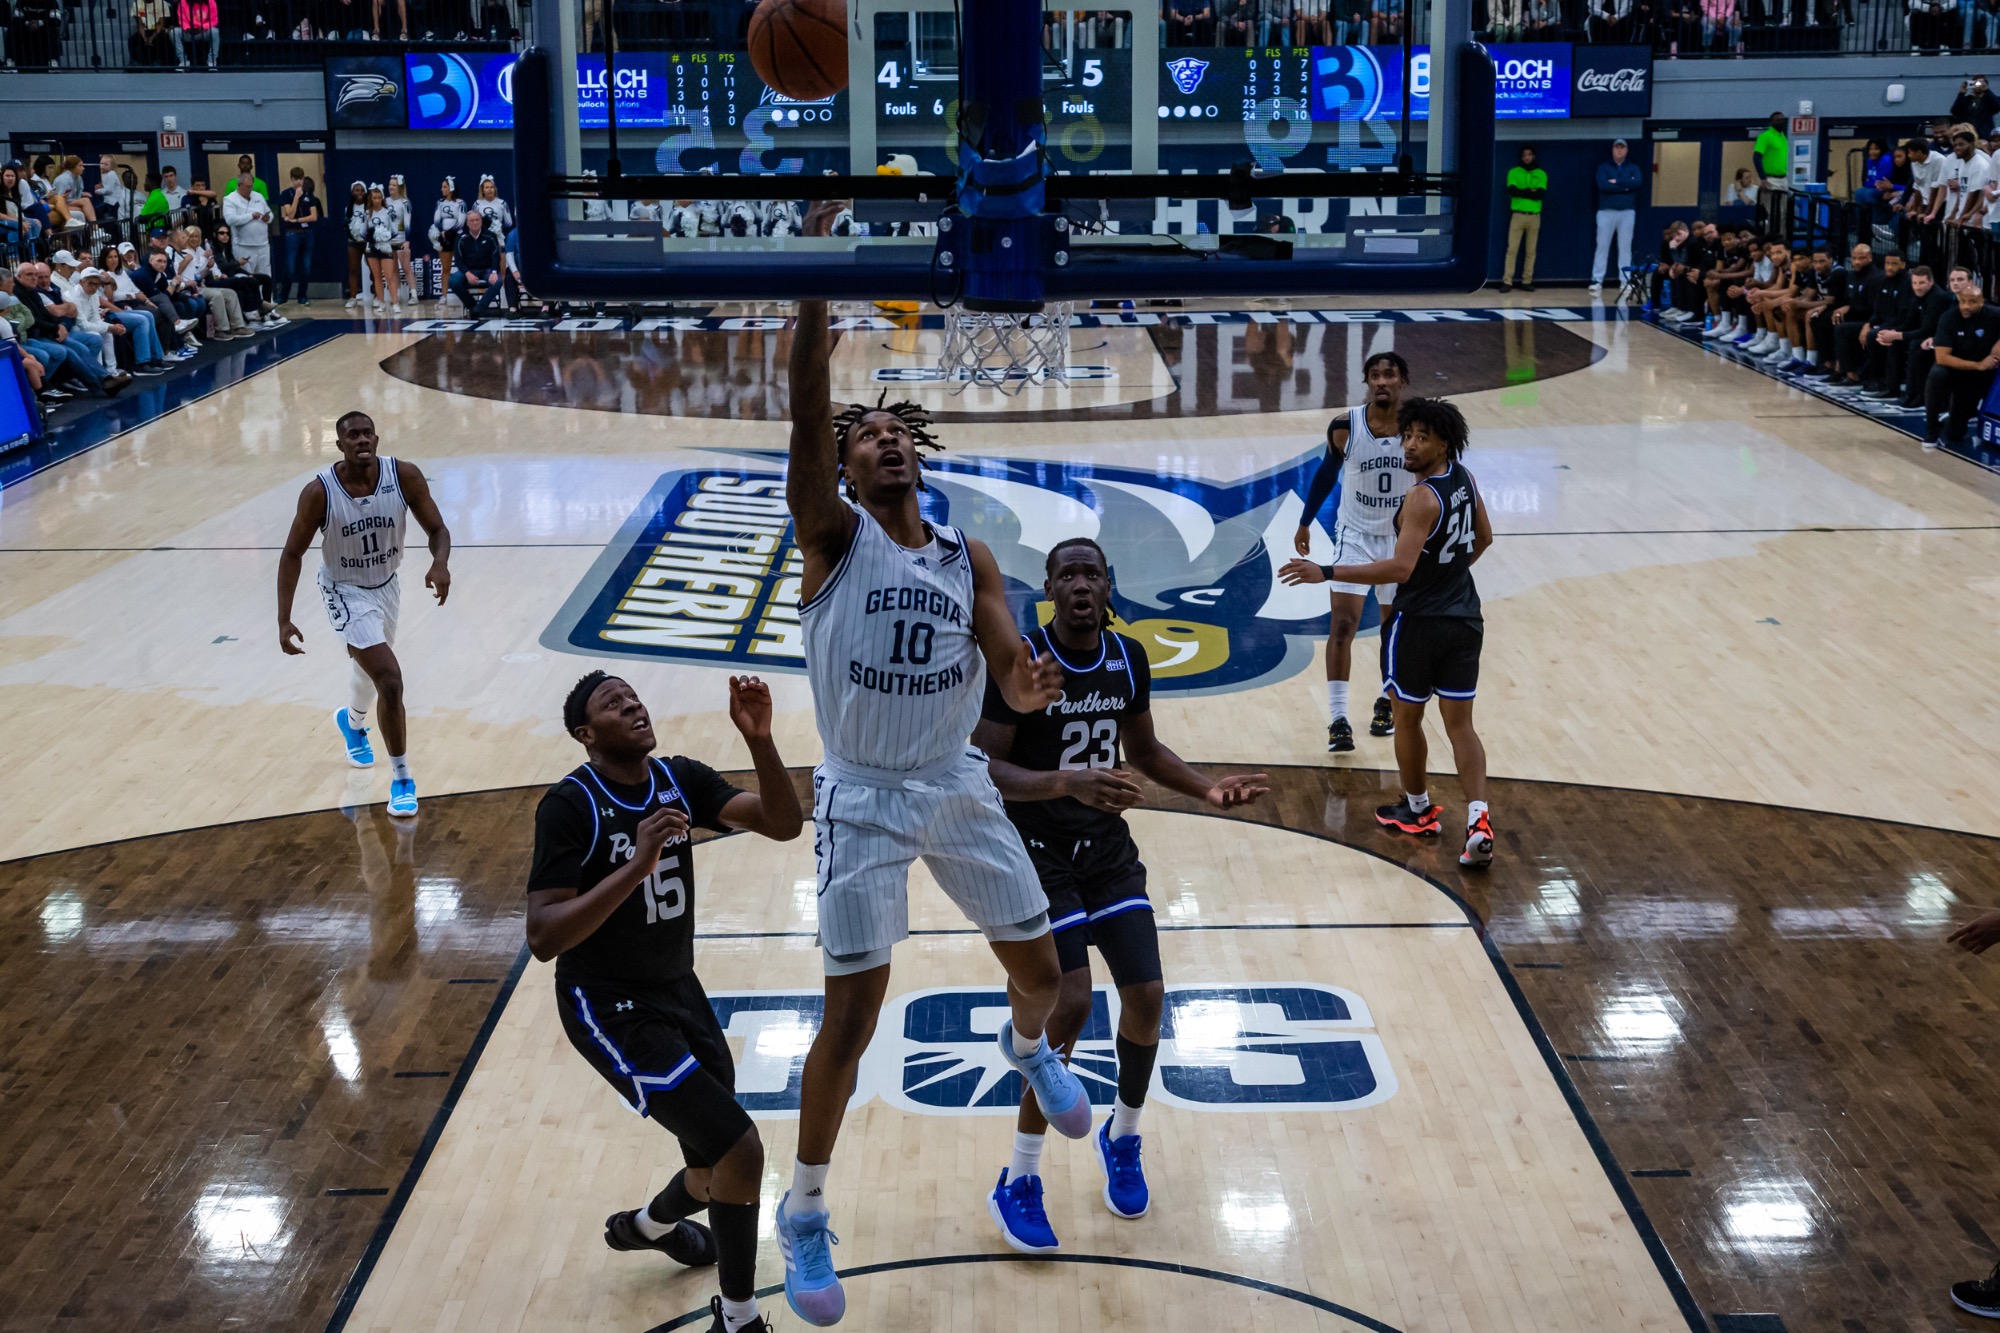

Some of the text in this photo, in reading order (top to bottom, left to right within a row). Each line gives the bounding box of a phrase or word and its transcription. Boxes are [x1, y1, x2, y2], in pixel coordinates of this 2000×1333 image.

[692, 54, 707, 62] FLS
[719, 54, 735, 62] PTS
[1265, 49, 1281, 57] FLS
[1293, 49, 1309, 57] PTS
[676, 65, 734, 75] 0 1 7
[1250, 59, 1308, 69] 0 0 7
[877, 61, 900, 88] 4
[1082, 59, 1103, 87] 5
[1249, 72, 1308, 82] 5 2 5
[1577, 68, 1646, 92] Coca-Cola
[677, 77, 735, 87] 2 0 11
[677, 91, 734, 100] 3 0 9
[1243, 86, 1308, 95] 15 3 4
[672, 104, 735, 114] 10 4 3
[885, 99, 944, 115] Fouls 6
[1062, 101, 1094, 113] Fouls
[1243, 99, 1307, 109] 23 0 2
[675, 116, 736, 125] 11 3 0
[1243, 111, 1307, 120] 24 0 10
[1795, 118, 1814, 132] EXIT
[163, 133, 183, 149] EXIT
[402, 317, 901, 332] GEORGA
[1378, 472, 1391, 494] 0
[342, 516, 396, 538] GEORGIA
[1438, 503, 1477, 564] 24
[361, 532, 380, 556] 11
[341, 546, 400, 569] SOUTHERN
[865, 587, 962, 629] GEORGIA
[889, 619, 936, 665] 10
[1105, 659, 1126, 672] SBC
[850, 660, 963, 696] SOUTHERN
[1046, 690, 1126, 716] Panthers
[1059, 718, 1118, 771] 23
[608, 831, 689, 864] Paers
[639, 855, 686, 925] 15
